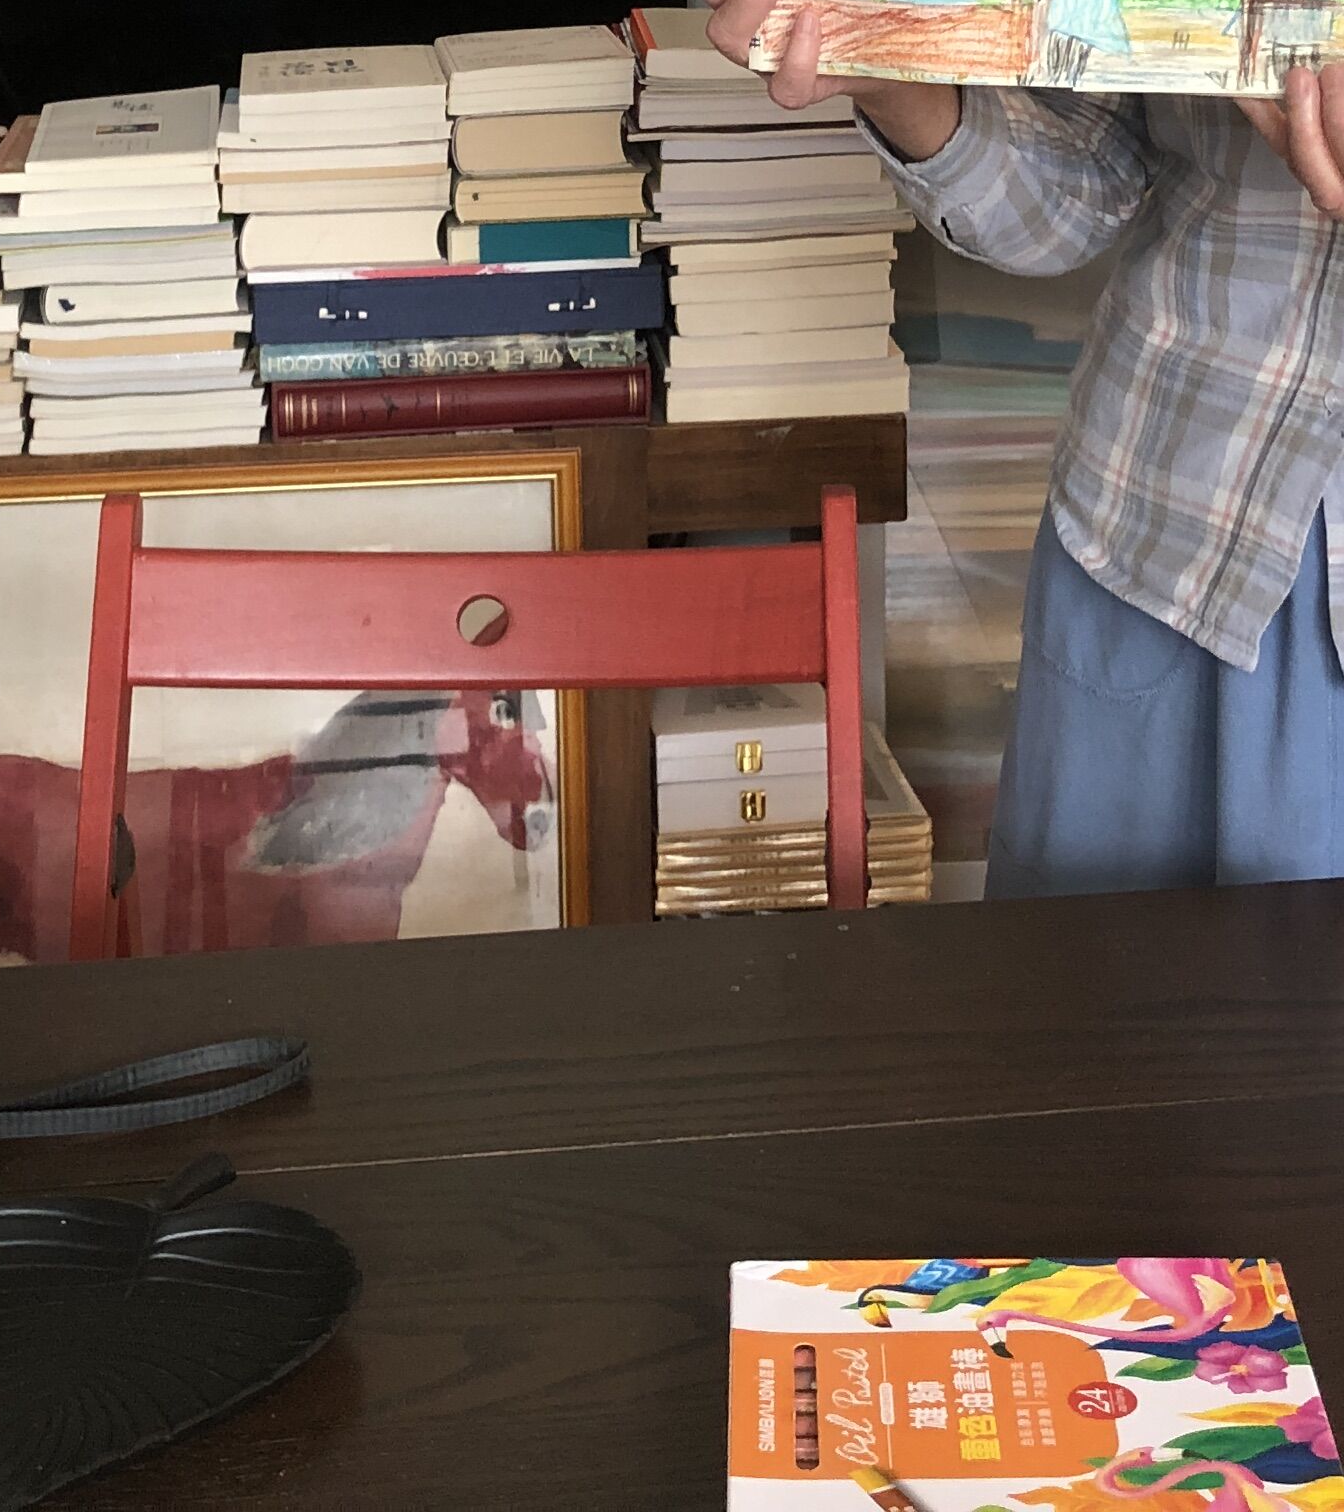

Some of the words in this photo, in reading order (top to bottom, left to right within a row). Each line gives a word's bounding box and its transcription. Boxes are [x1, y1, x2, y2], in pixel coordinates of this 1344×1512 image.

[329, 354, 370, 370] VAN
[376, 352, 402, 369] DE
[503, 348, 525, 365] ET
[532, 347, 564, 365] VIE
[569, 346, 594, 363] LA
[266, 355, 323, 372] GOGH
[831, 1346, 873, 1409] Pastel
[1075, 1387, 1111, 1414] 24
[825, 1412, 879, 1466] Oil
